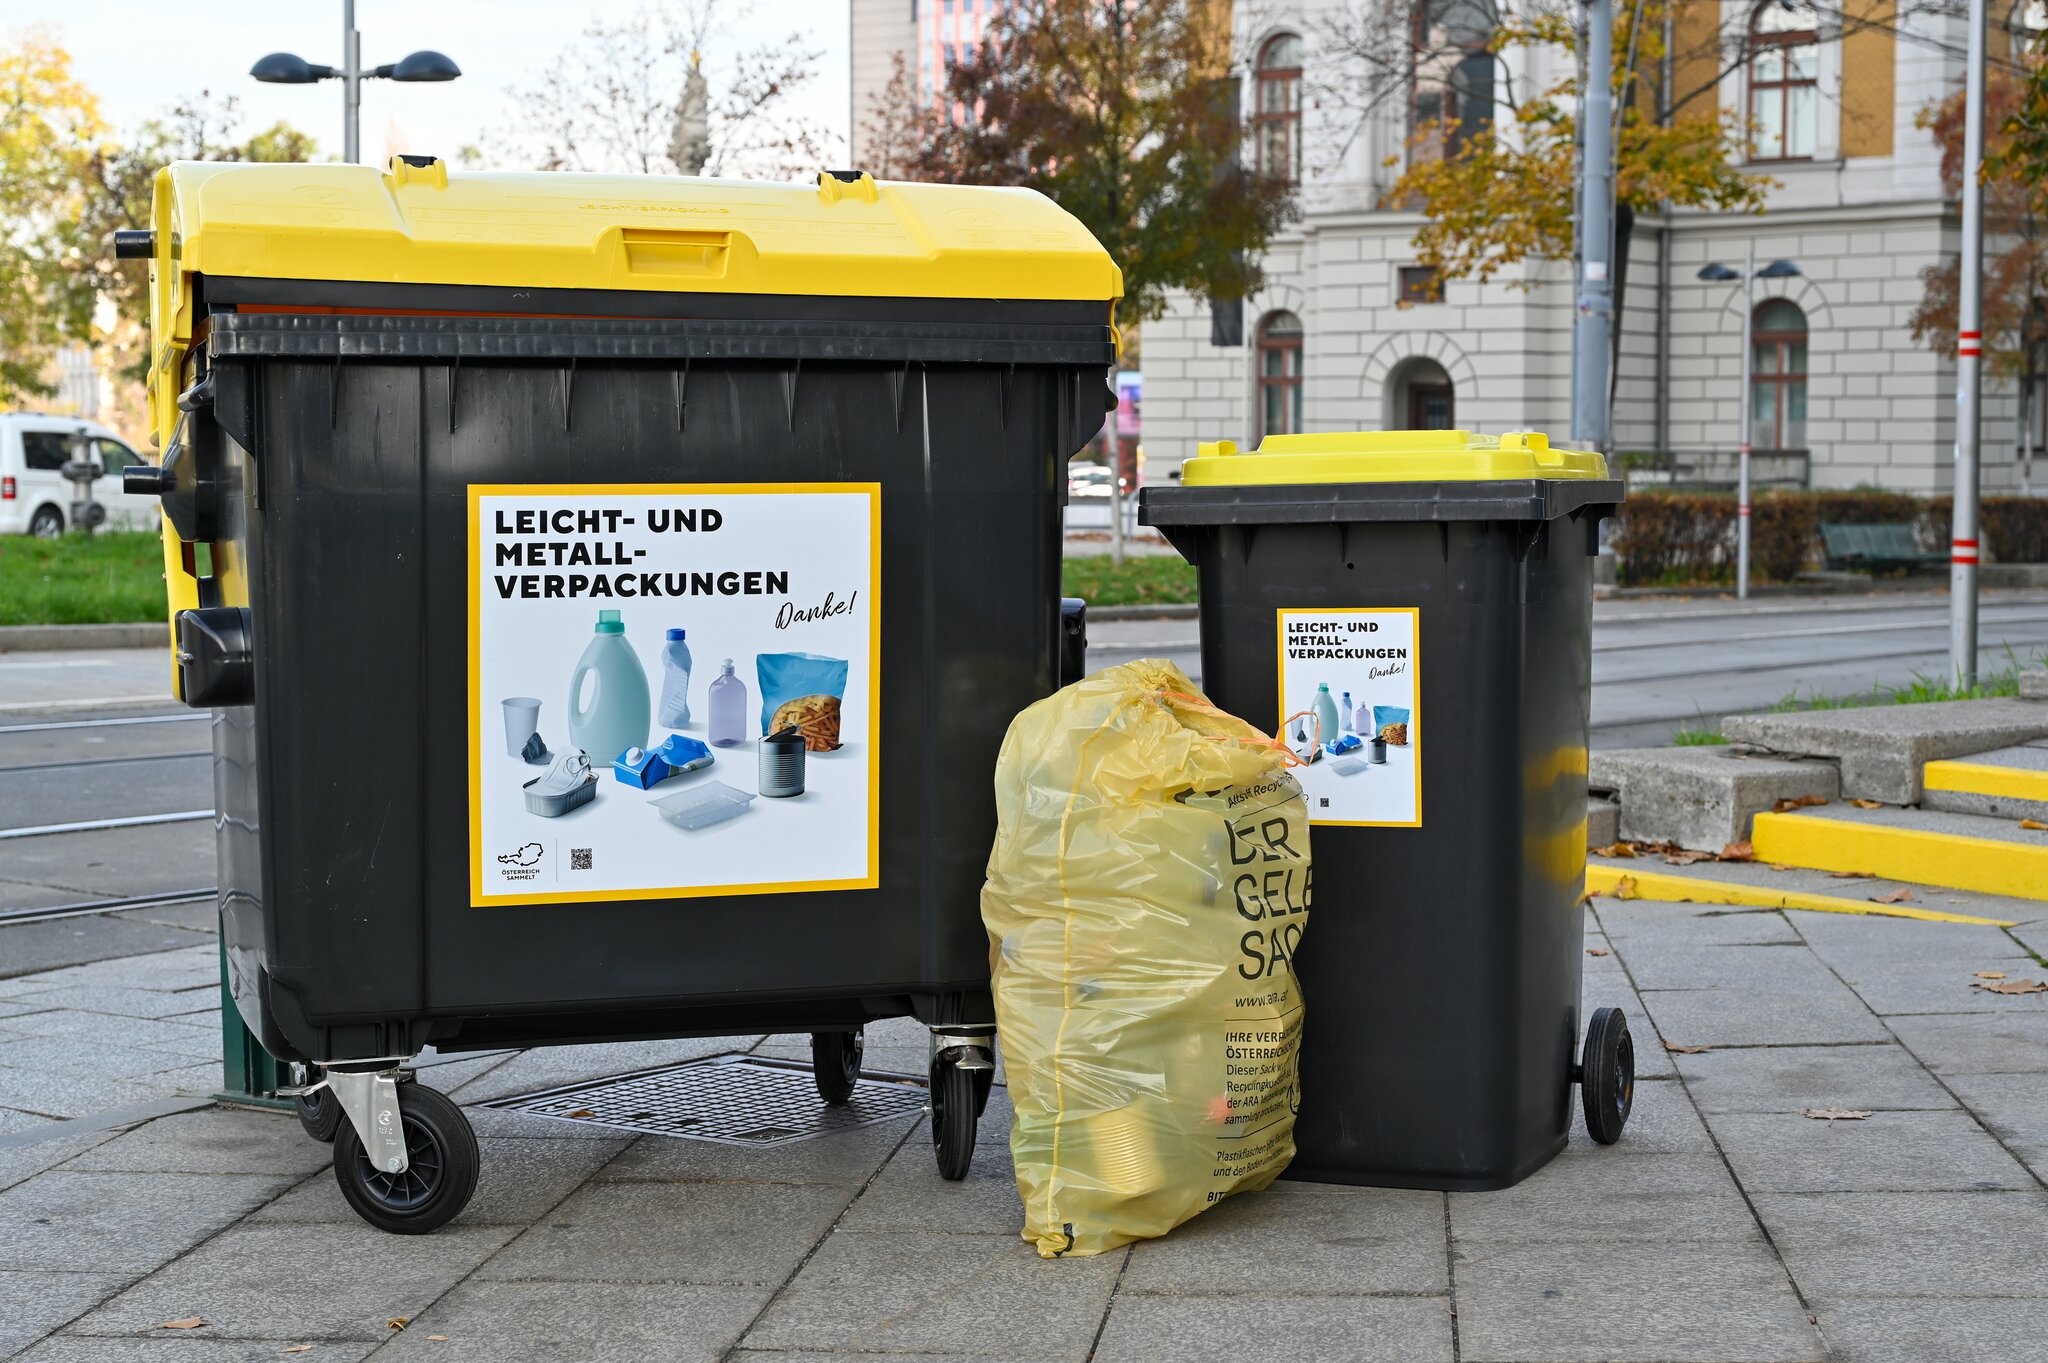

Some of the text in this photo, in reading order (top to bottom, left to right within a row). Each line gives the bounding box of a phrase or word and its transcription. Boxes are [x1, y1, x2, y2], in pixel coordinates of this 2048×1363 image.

[495, 508, 723, 534] LEICHT- UND
[495, 541, 647, 566] METALL-
[494, 570, 789, 599] VERPACKUNGEN
[774, 590, 857, 630] Danke!
[1288, 622, 1379, 633] LEICHT- UND
[1288, 635, 1348, 646] METALL-
[1288, 648, 1407, 659] VERPACKUNGEN
[1368, 662, 1406, 680] Danke!
[501, 868, 540, 876] ÖSTERREICH
[1225, 1031, 1253, 1043] IHRE
[1226, 1064, 1258, 1076] Dieser
[1259, 1062, 1276, 1075] Sack
[1226, 1095, 1259, 1109] der ARA
[1213, 1167, 1232, 1177] und
[1206, 1191, 1227, 1202] BIT
